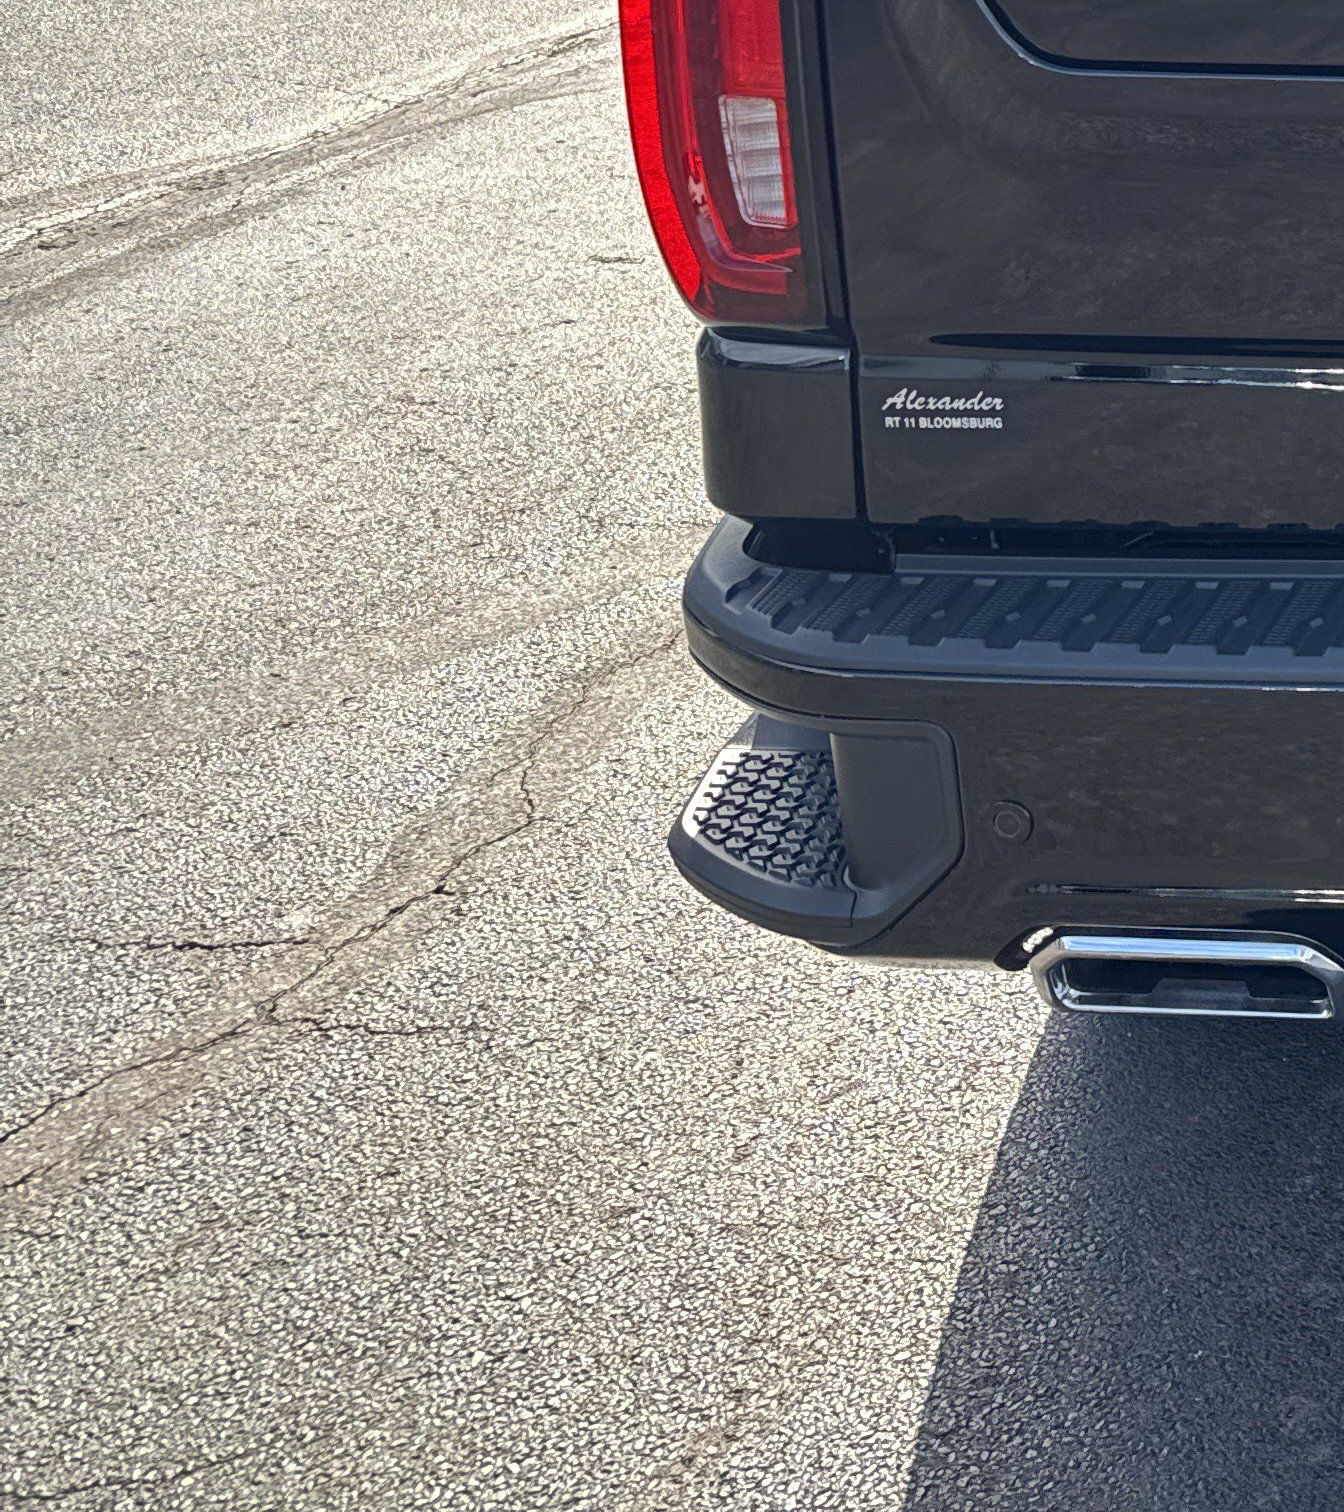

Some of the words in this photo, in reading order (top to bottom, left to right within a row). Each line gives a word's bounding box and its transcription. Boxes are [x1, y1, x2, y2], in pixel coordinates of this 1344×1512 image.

[881, 388, 1005, 411] Alexander
[884, 416, 901, 429] RT
[904, 417, 916, 429] 11
[918, 417, 1003, 429] BLOOMSBURG
